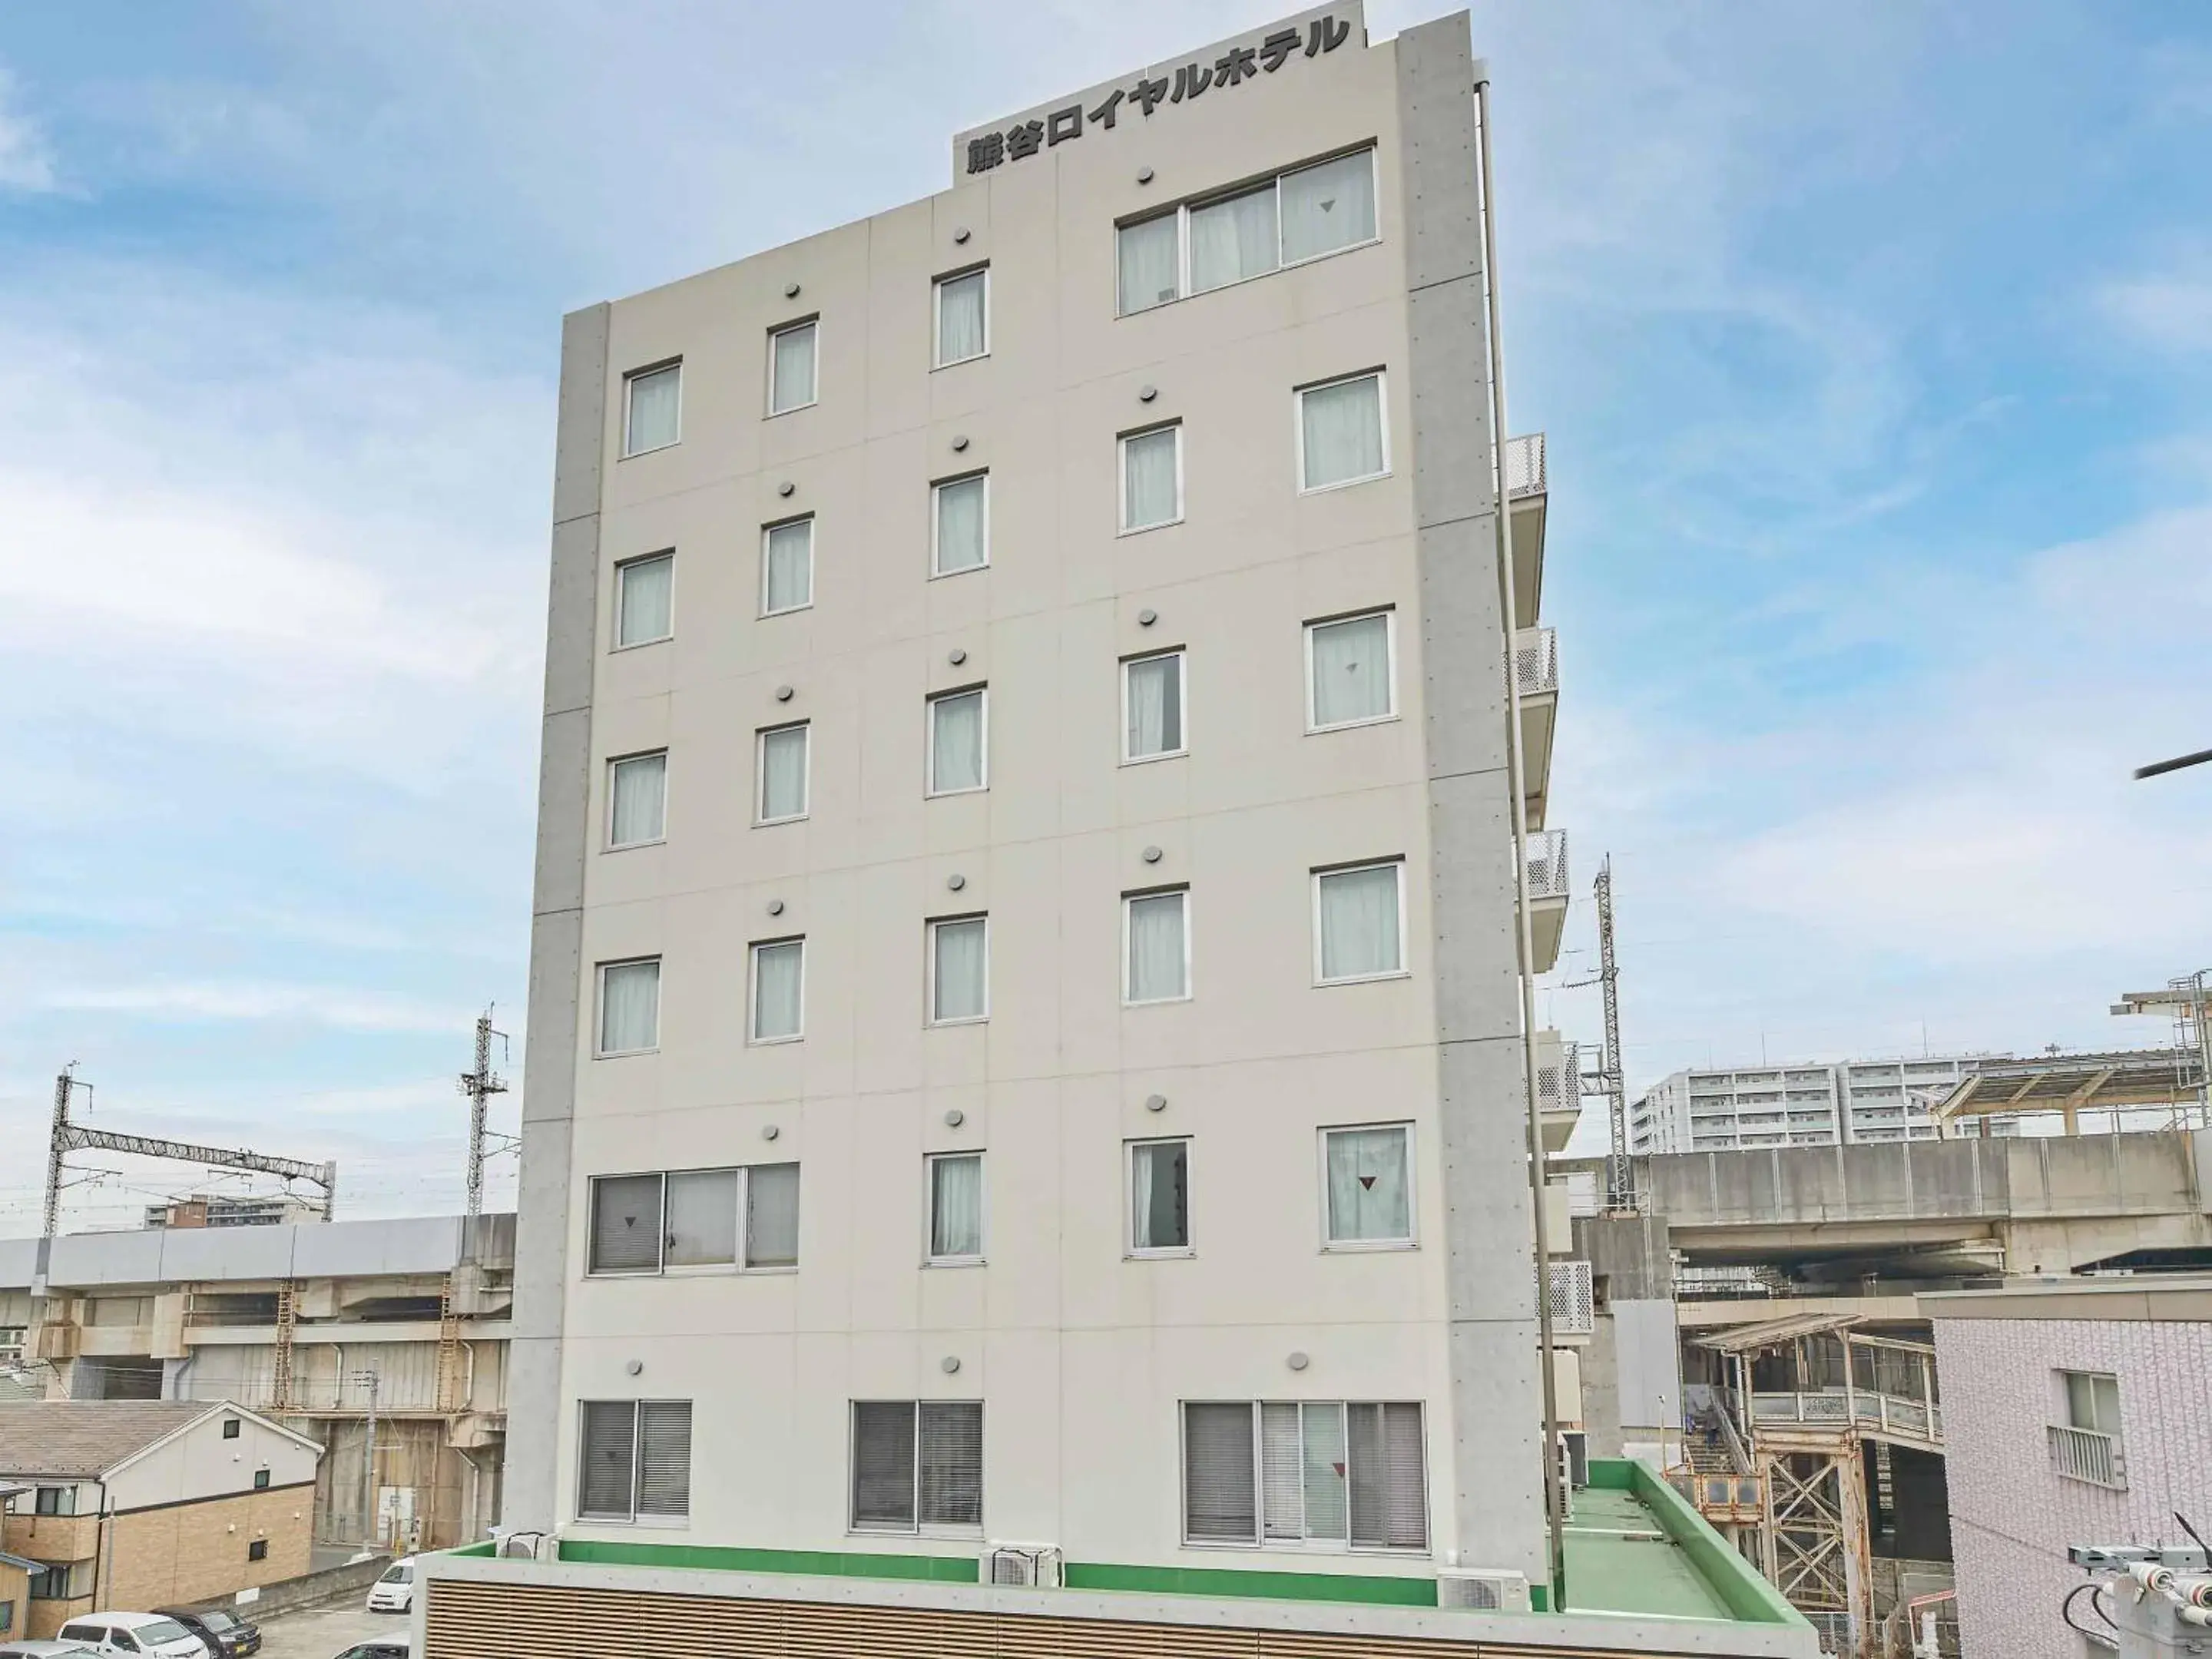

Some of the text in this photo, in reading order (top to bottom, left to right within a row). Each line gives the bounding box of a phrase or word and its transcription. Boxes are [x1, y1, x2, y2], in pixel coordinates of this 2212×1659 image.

[967, 15, 1349, 174] 熊谷ロイヤルホテル
